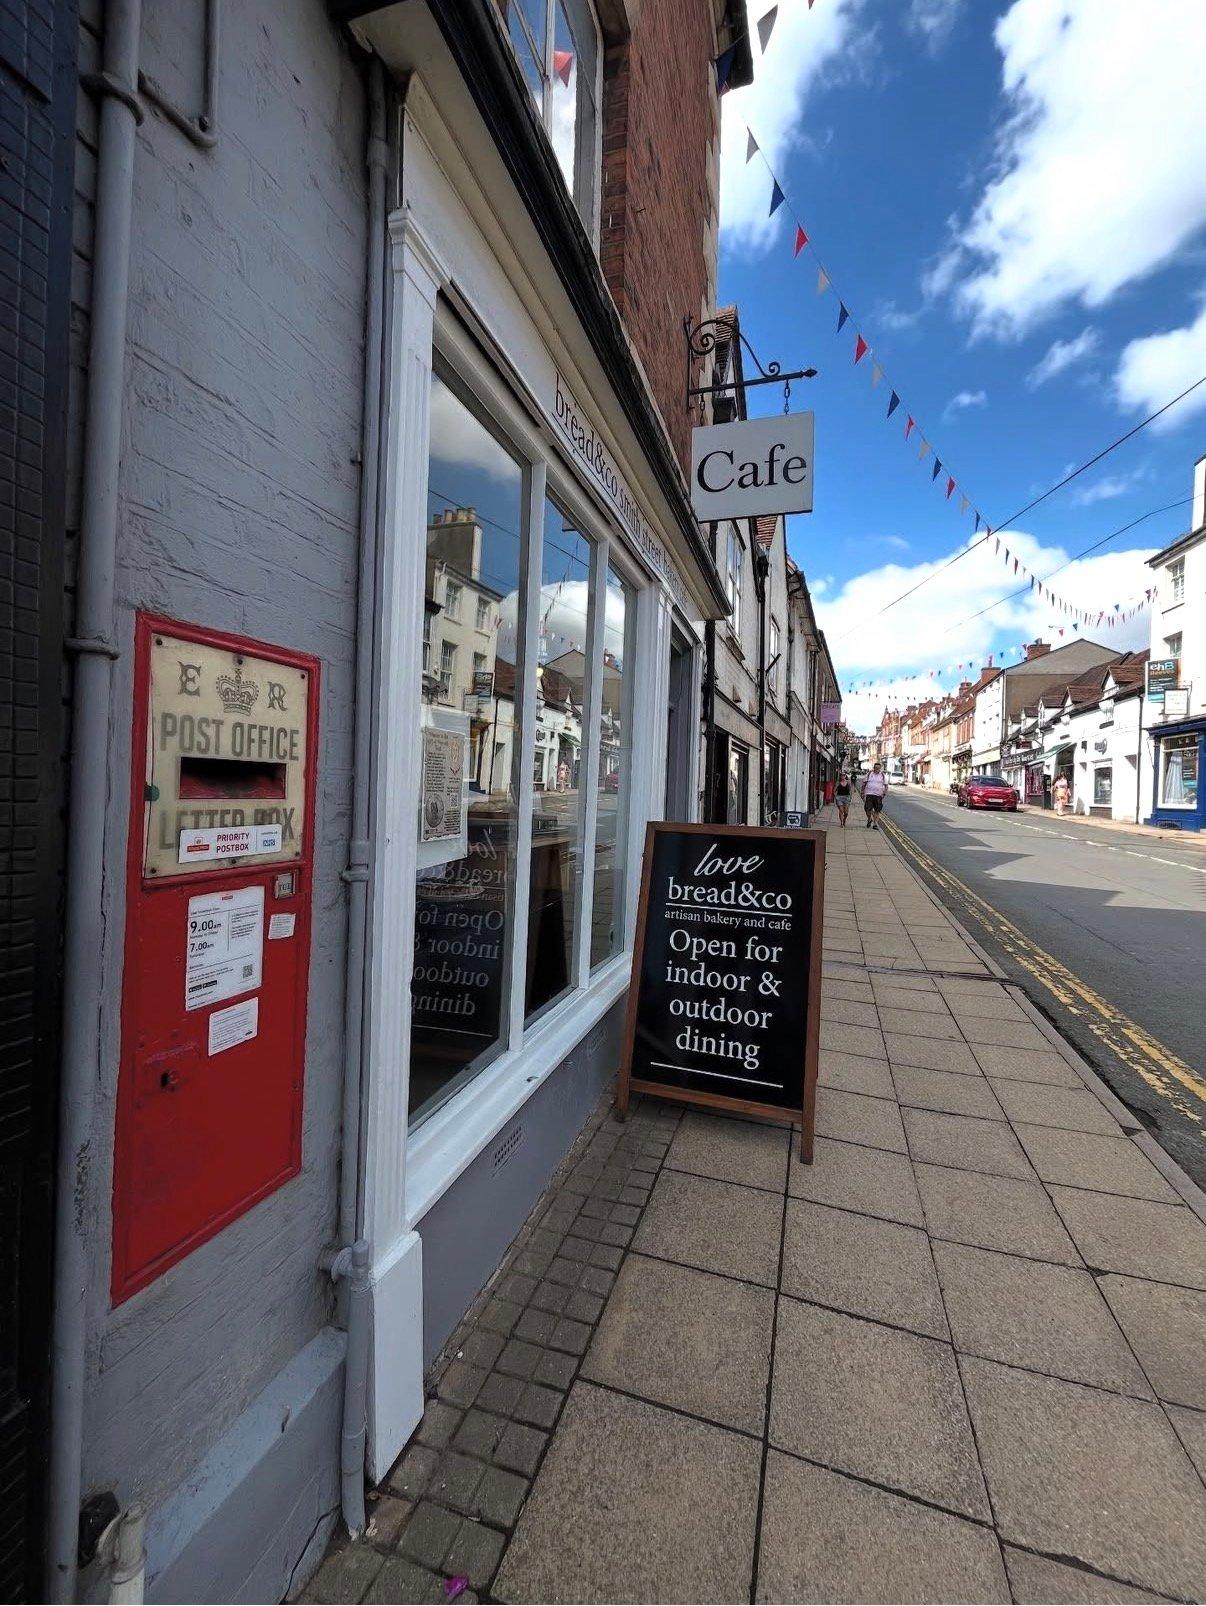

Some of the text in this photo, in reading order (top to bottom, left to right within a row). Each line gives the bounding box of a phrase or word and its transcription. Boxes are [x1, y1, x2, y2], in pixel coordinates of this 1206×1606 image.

[555, 371, 618, 498] bread&co
[697, 443, 807, 493] Cafe
[177, 660, 288, 712] E R
[160, 712, 299, 761] POST OFFICE
[216, 832, 250, 842] PRIORITY
[216, 843, 249, 853] POSTBOX
[693, 843, 765, 877] love
[668, 876, 793, 910] bread&co
[664, 909, 792, 931] artisan bakery and cafe
[669, 929, 783, 963] Open for
[665, 960, 783, 997] indoor &
[669, 998, 773, 1029] outdoor
[675, 1026, 761, 1070] dining
